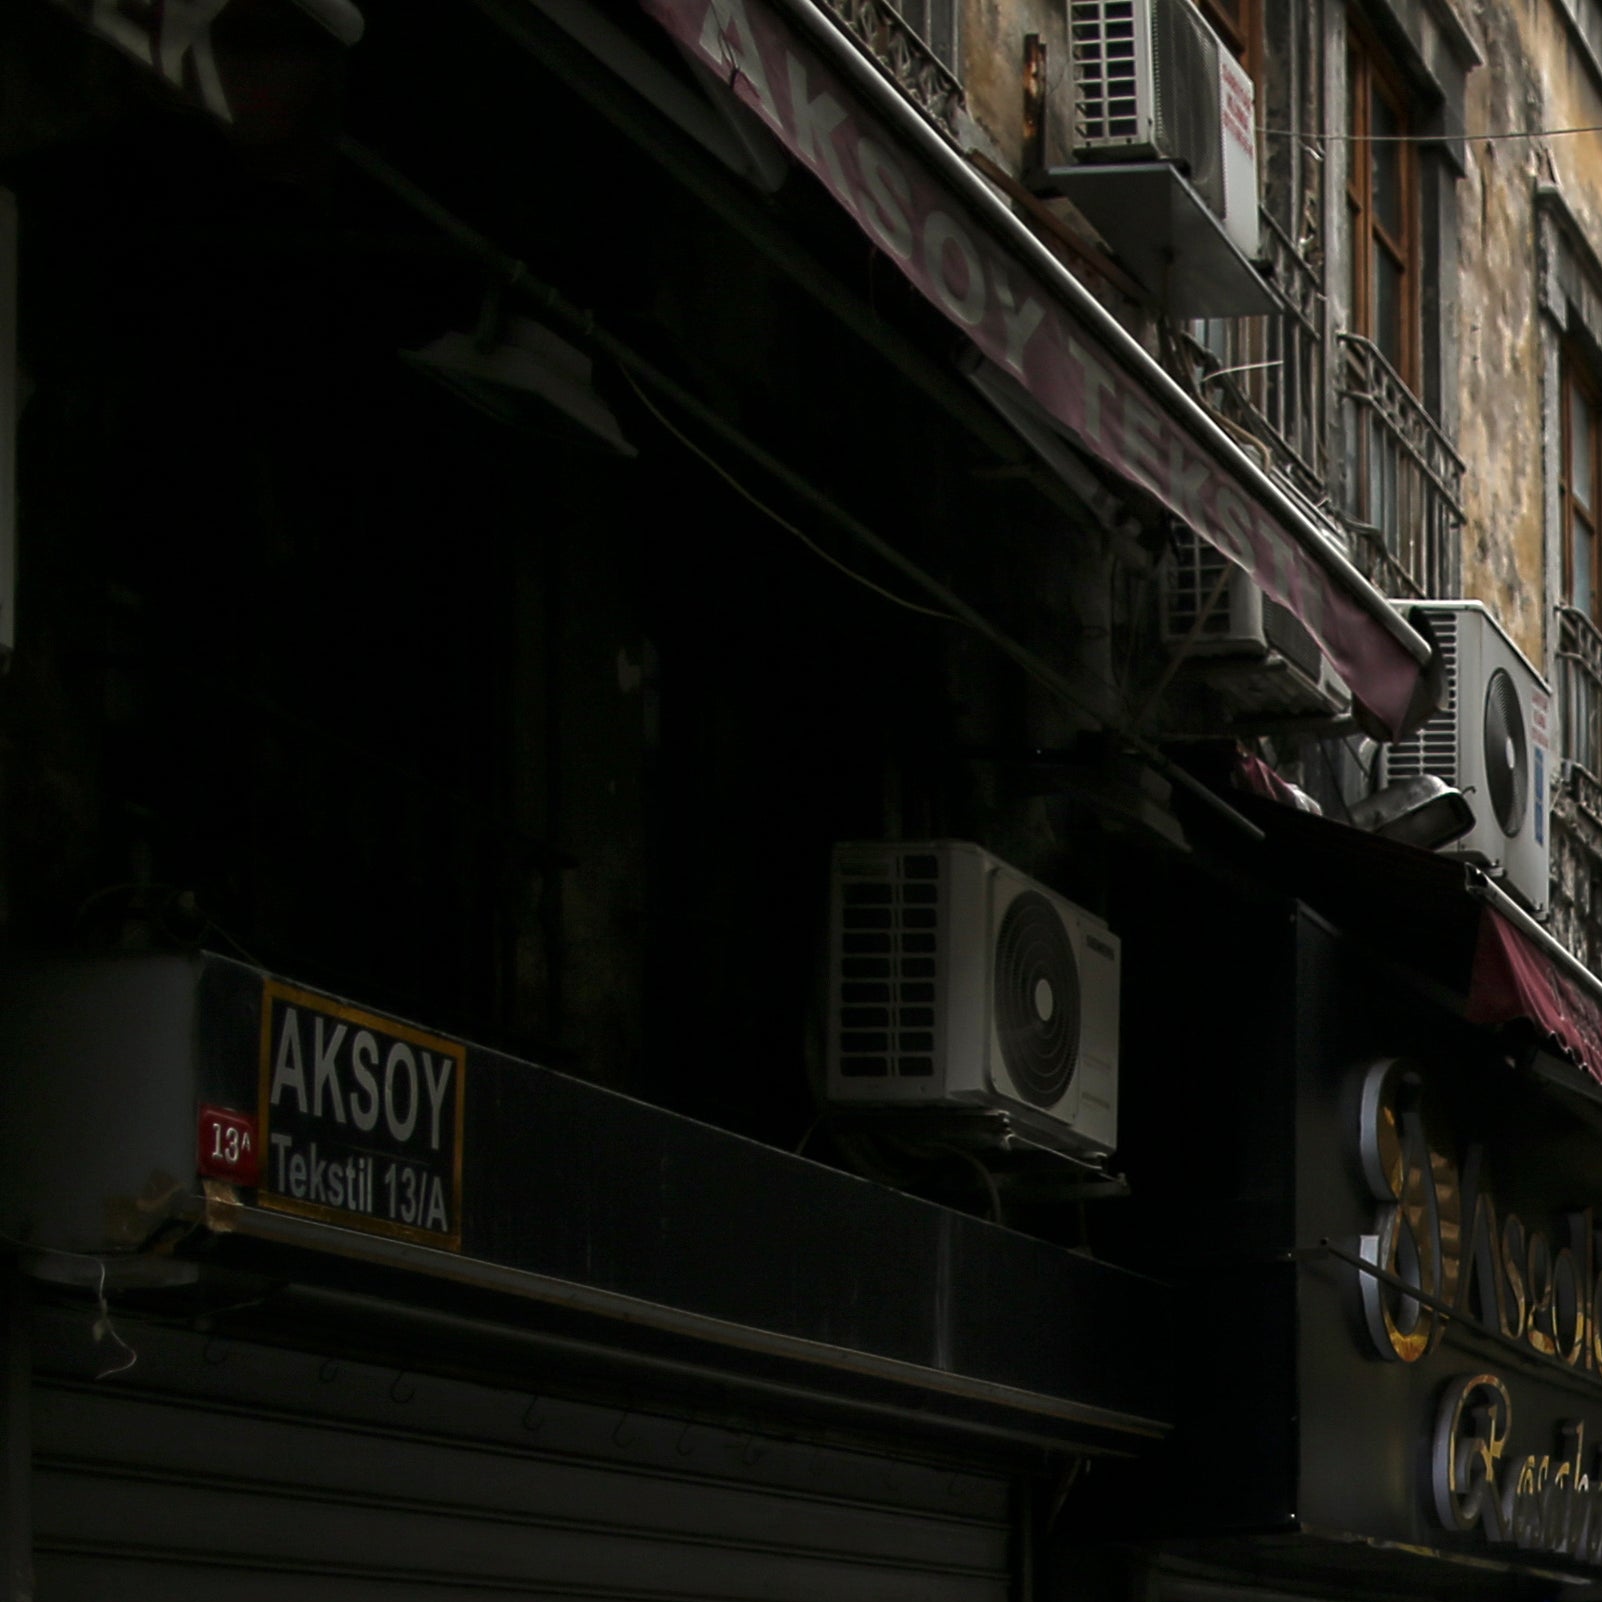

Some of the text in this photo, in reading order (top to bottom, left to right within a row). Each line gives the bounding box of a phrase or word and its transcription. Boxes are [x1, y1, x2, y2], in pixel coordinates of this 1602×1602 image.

[270, 1007, 453, 1150] AKSOY
[270, 1132, 448, 1232] Tekstil 13/A
